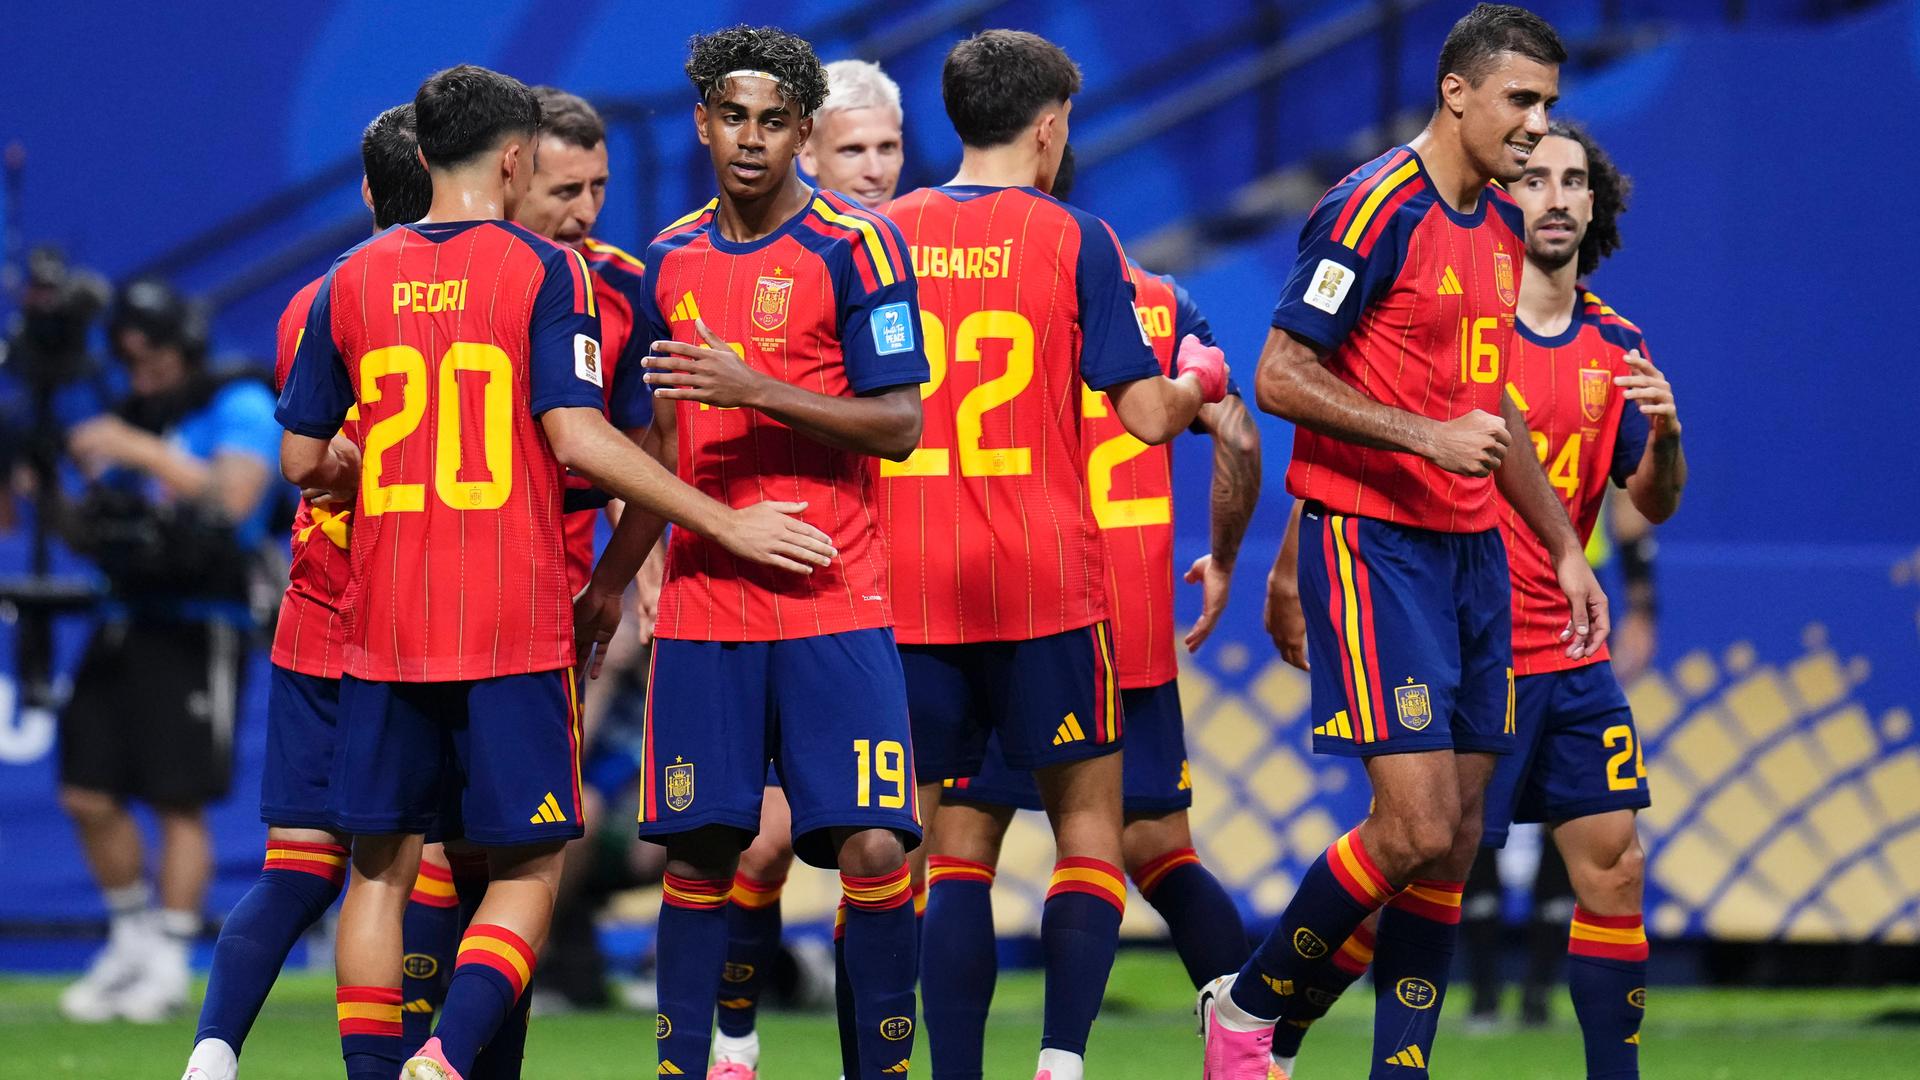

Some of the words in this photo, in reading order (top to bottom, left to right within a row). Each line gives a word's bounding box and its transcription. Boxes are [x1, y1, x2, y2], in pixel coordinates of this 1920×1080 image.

[392, 279, 468, 314] PEDRI
[1461, 317, 1500, 383] 16
[360, 341, 512, 517] 20
[854, 739, 905, 809] 19
[1405, 992, 1428, 1002] EF
[1407, 982, 1429, 993] RF
[888, 1021, 906, 1030] RF
